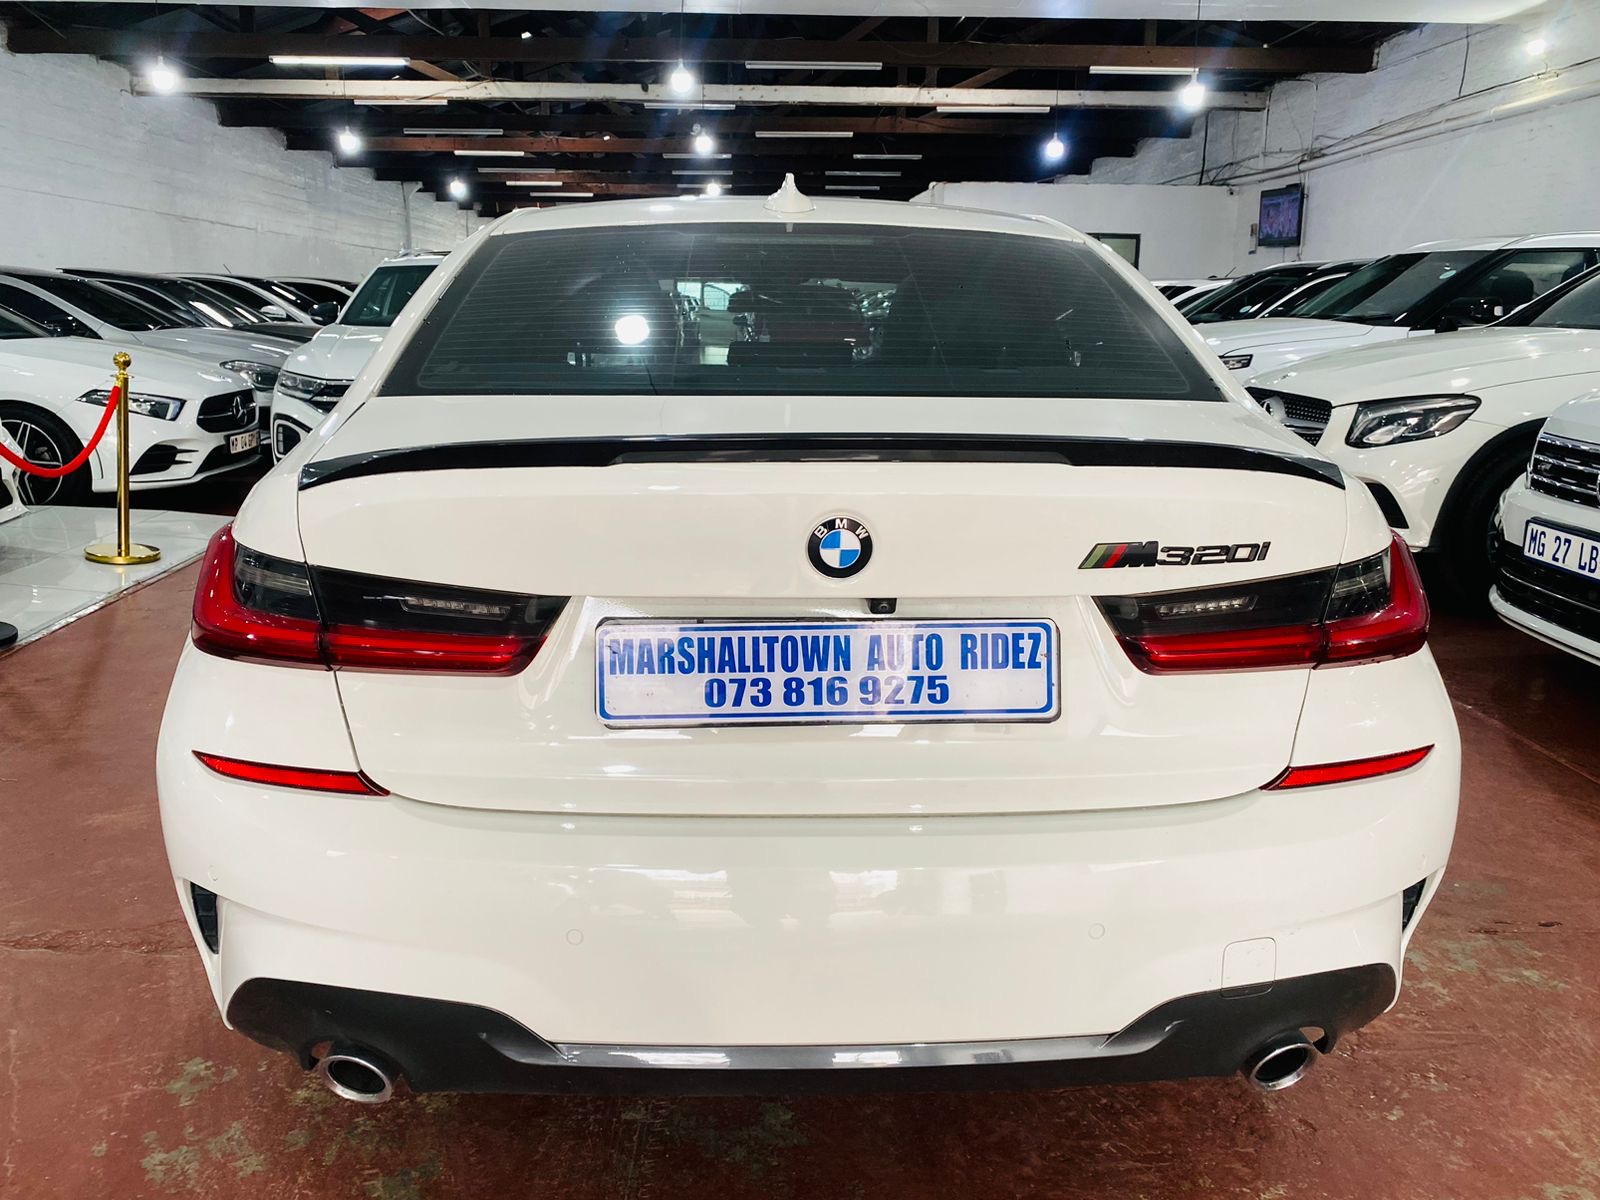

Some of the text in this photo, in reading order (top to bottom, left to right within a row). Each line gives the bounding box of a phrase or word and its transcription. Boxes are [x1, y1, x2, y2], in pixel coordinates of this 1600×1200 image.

[813, 518, 869, 540] BMW
[1527, 527, 1599, 574] MG 27 LB
[609, 632, 1042, 675] MARSHALLTOWN AUTO RIDEZ
[704, 674, 950, 708] 073 816 9275
